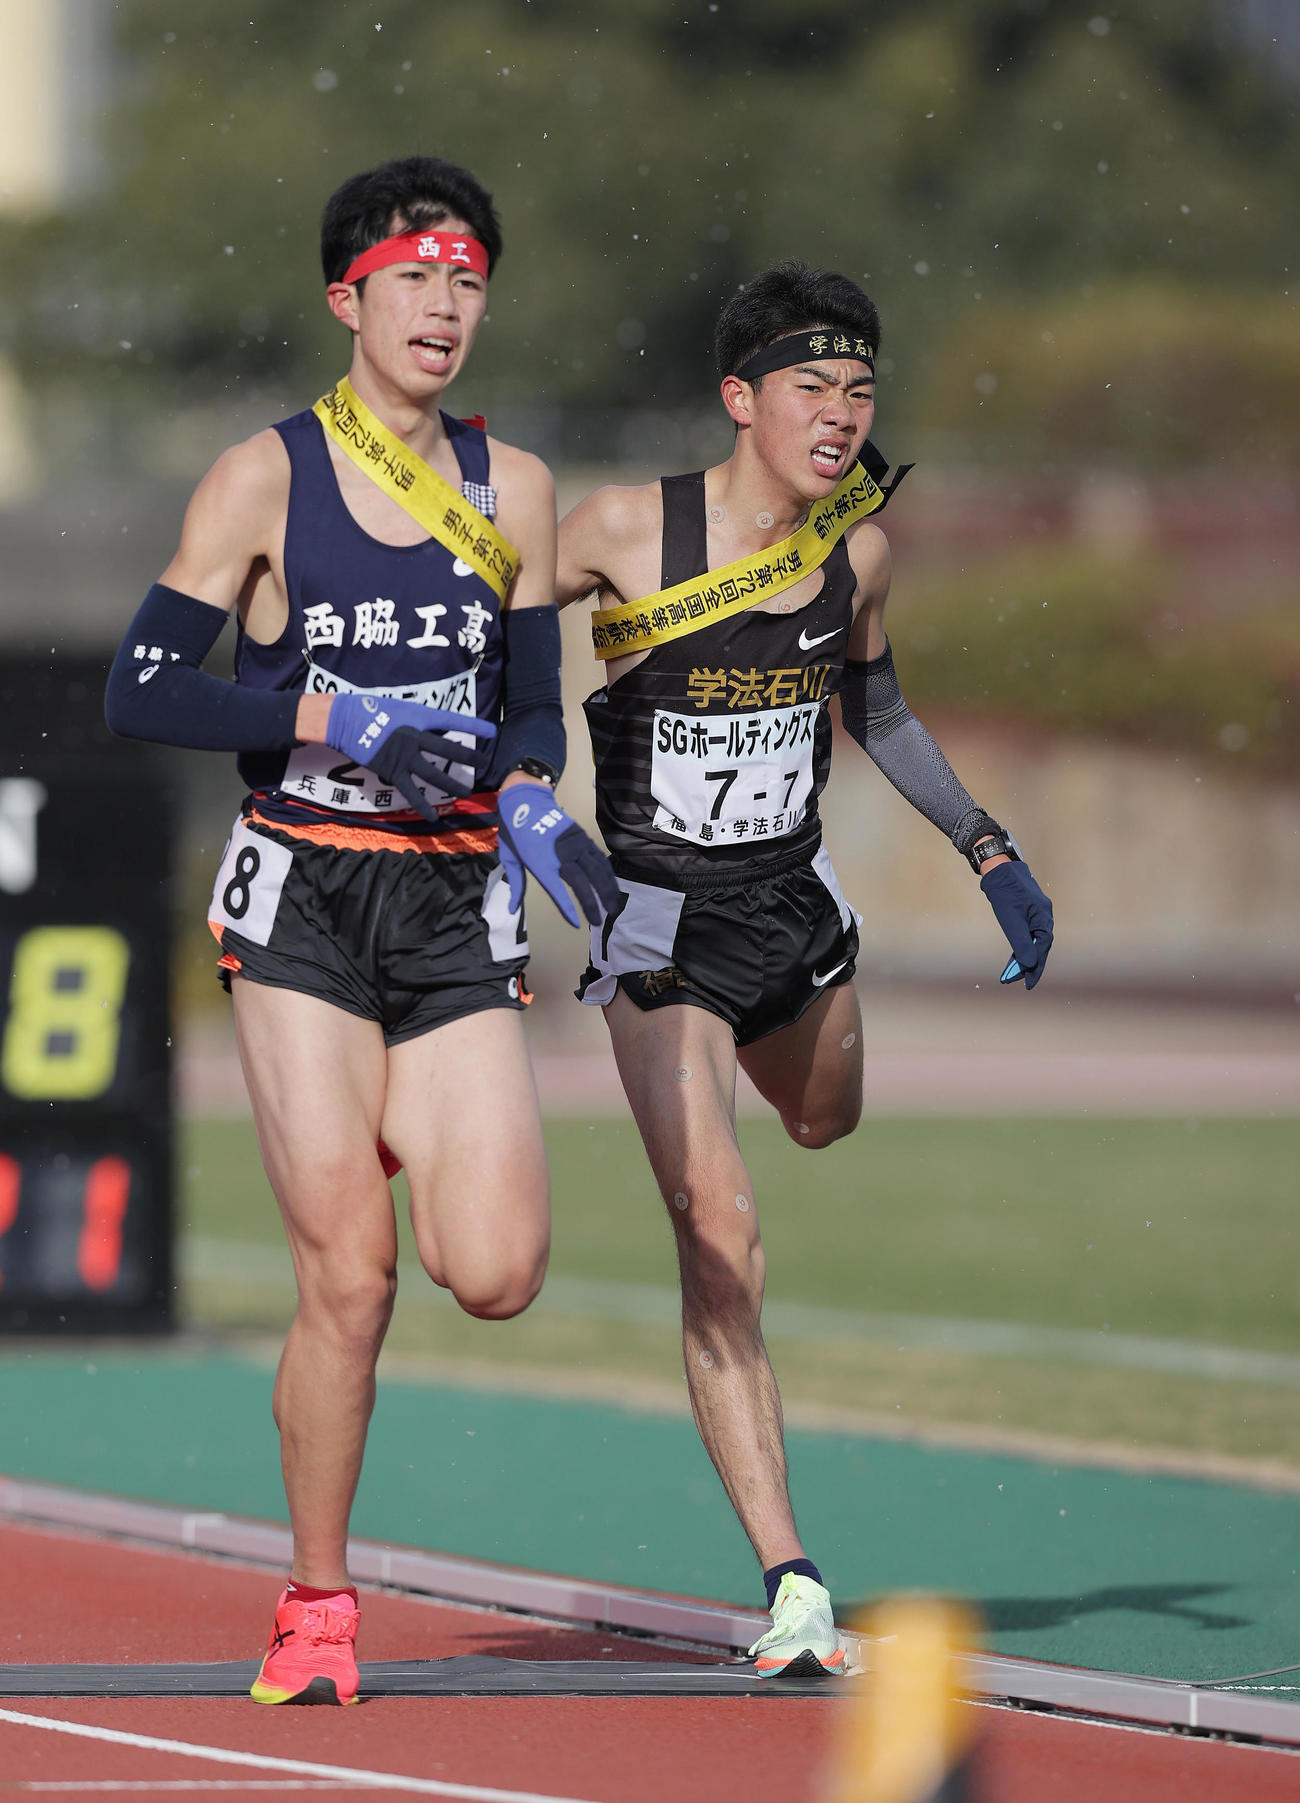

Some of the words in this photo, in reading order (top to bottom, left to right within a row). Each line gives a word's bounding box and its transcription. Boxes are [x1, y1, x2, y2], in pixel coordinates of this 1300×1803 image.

[418, 236, 471, 264] 西工
[686, 664, 831, 709] 学法石川
[657, 708, 813, 759] SGホールディングス
[222, 845, 261, 920] 8
[2, 925, 130, 1099] 8
